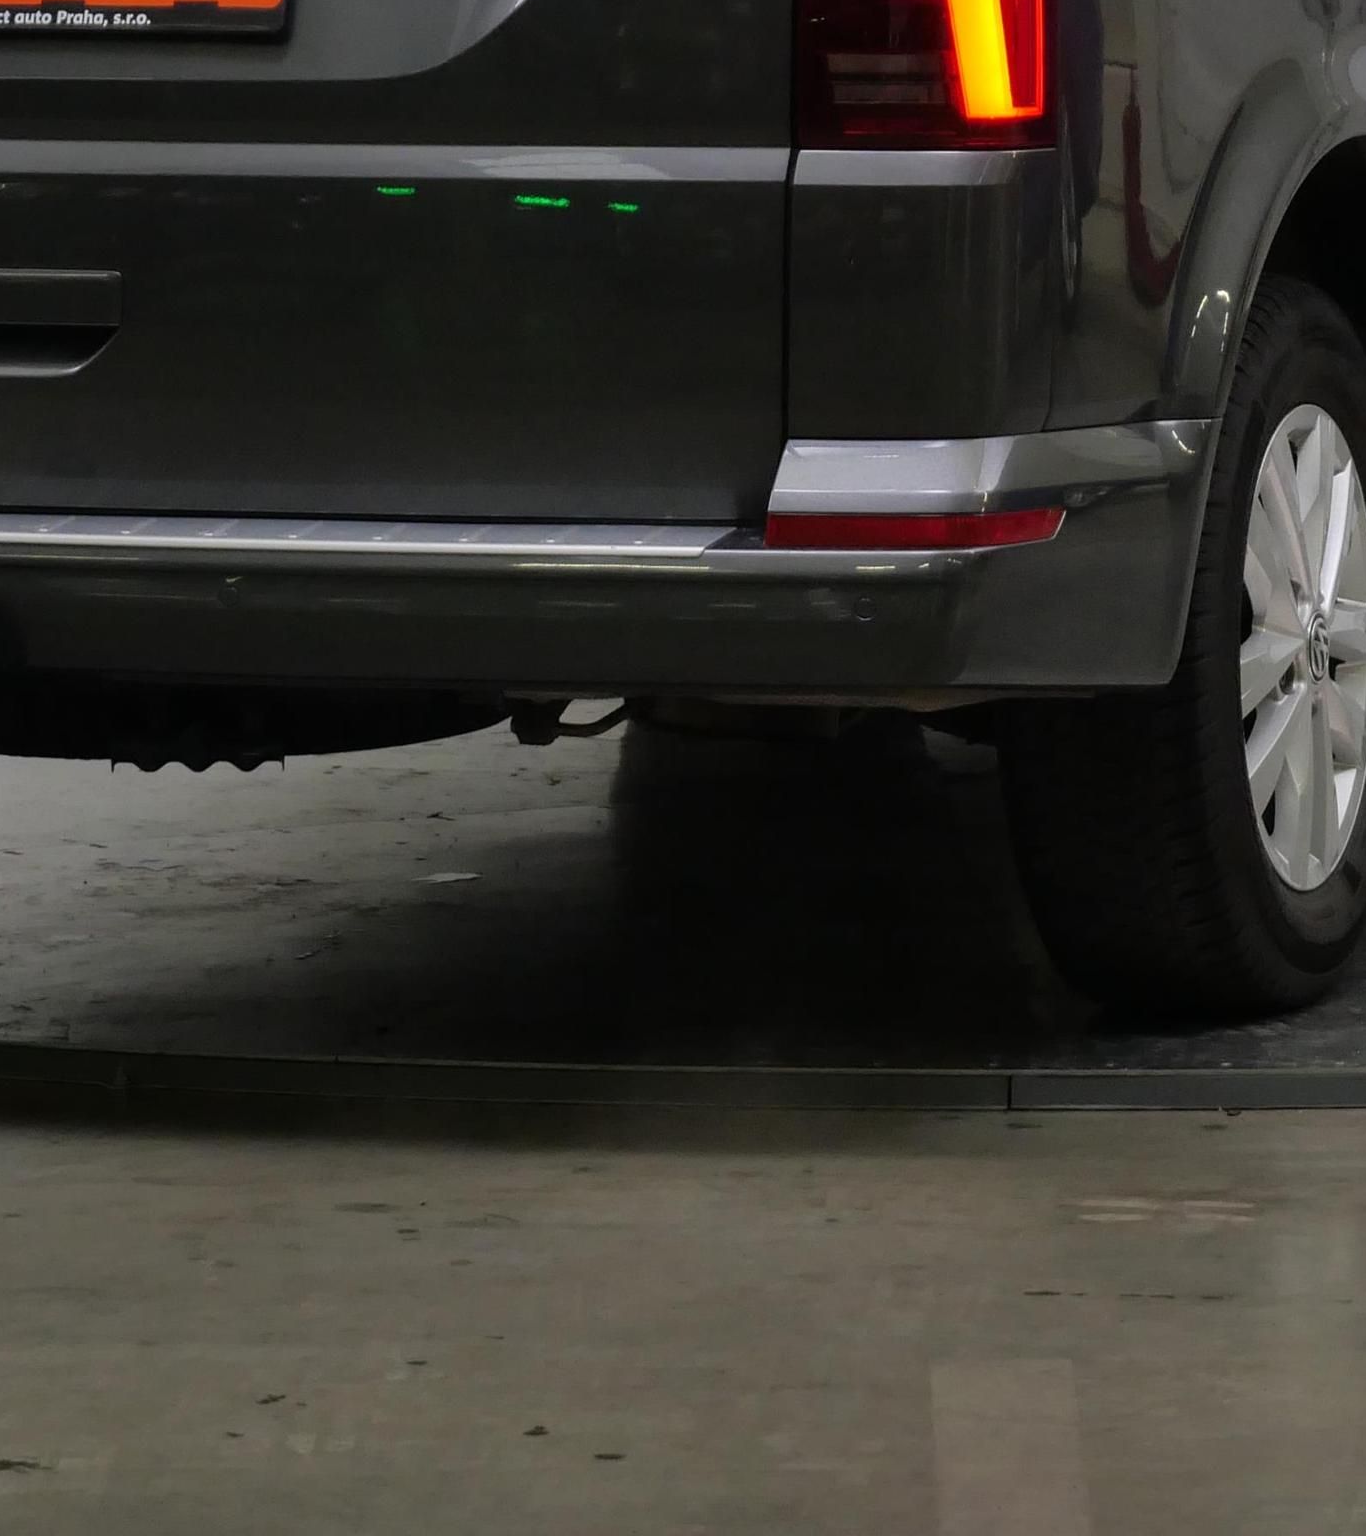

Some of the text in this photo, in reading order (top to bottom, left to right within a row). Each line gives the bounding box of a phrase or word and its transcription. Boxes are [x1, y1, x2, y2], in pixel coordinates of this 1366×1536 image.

[14, 10, 52, 25] auto
[56, 10, 109, 27] Praha,
[113, 12, 151, 25] s.r.o.
